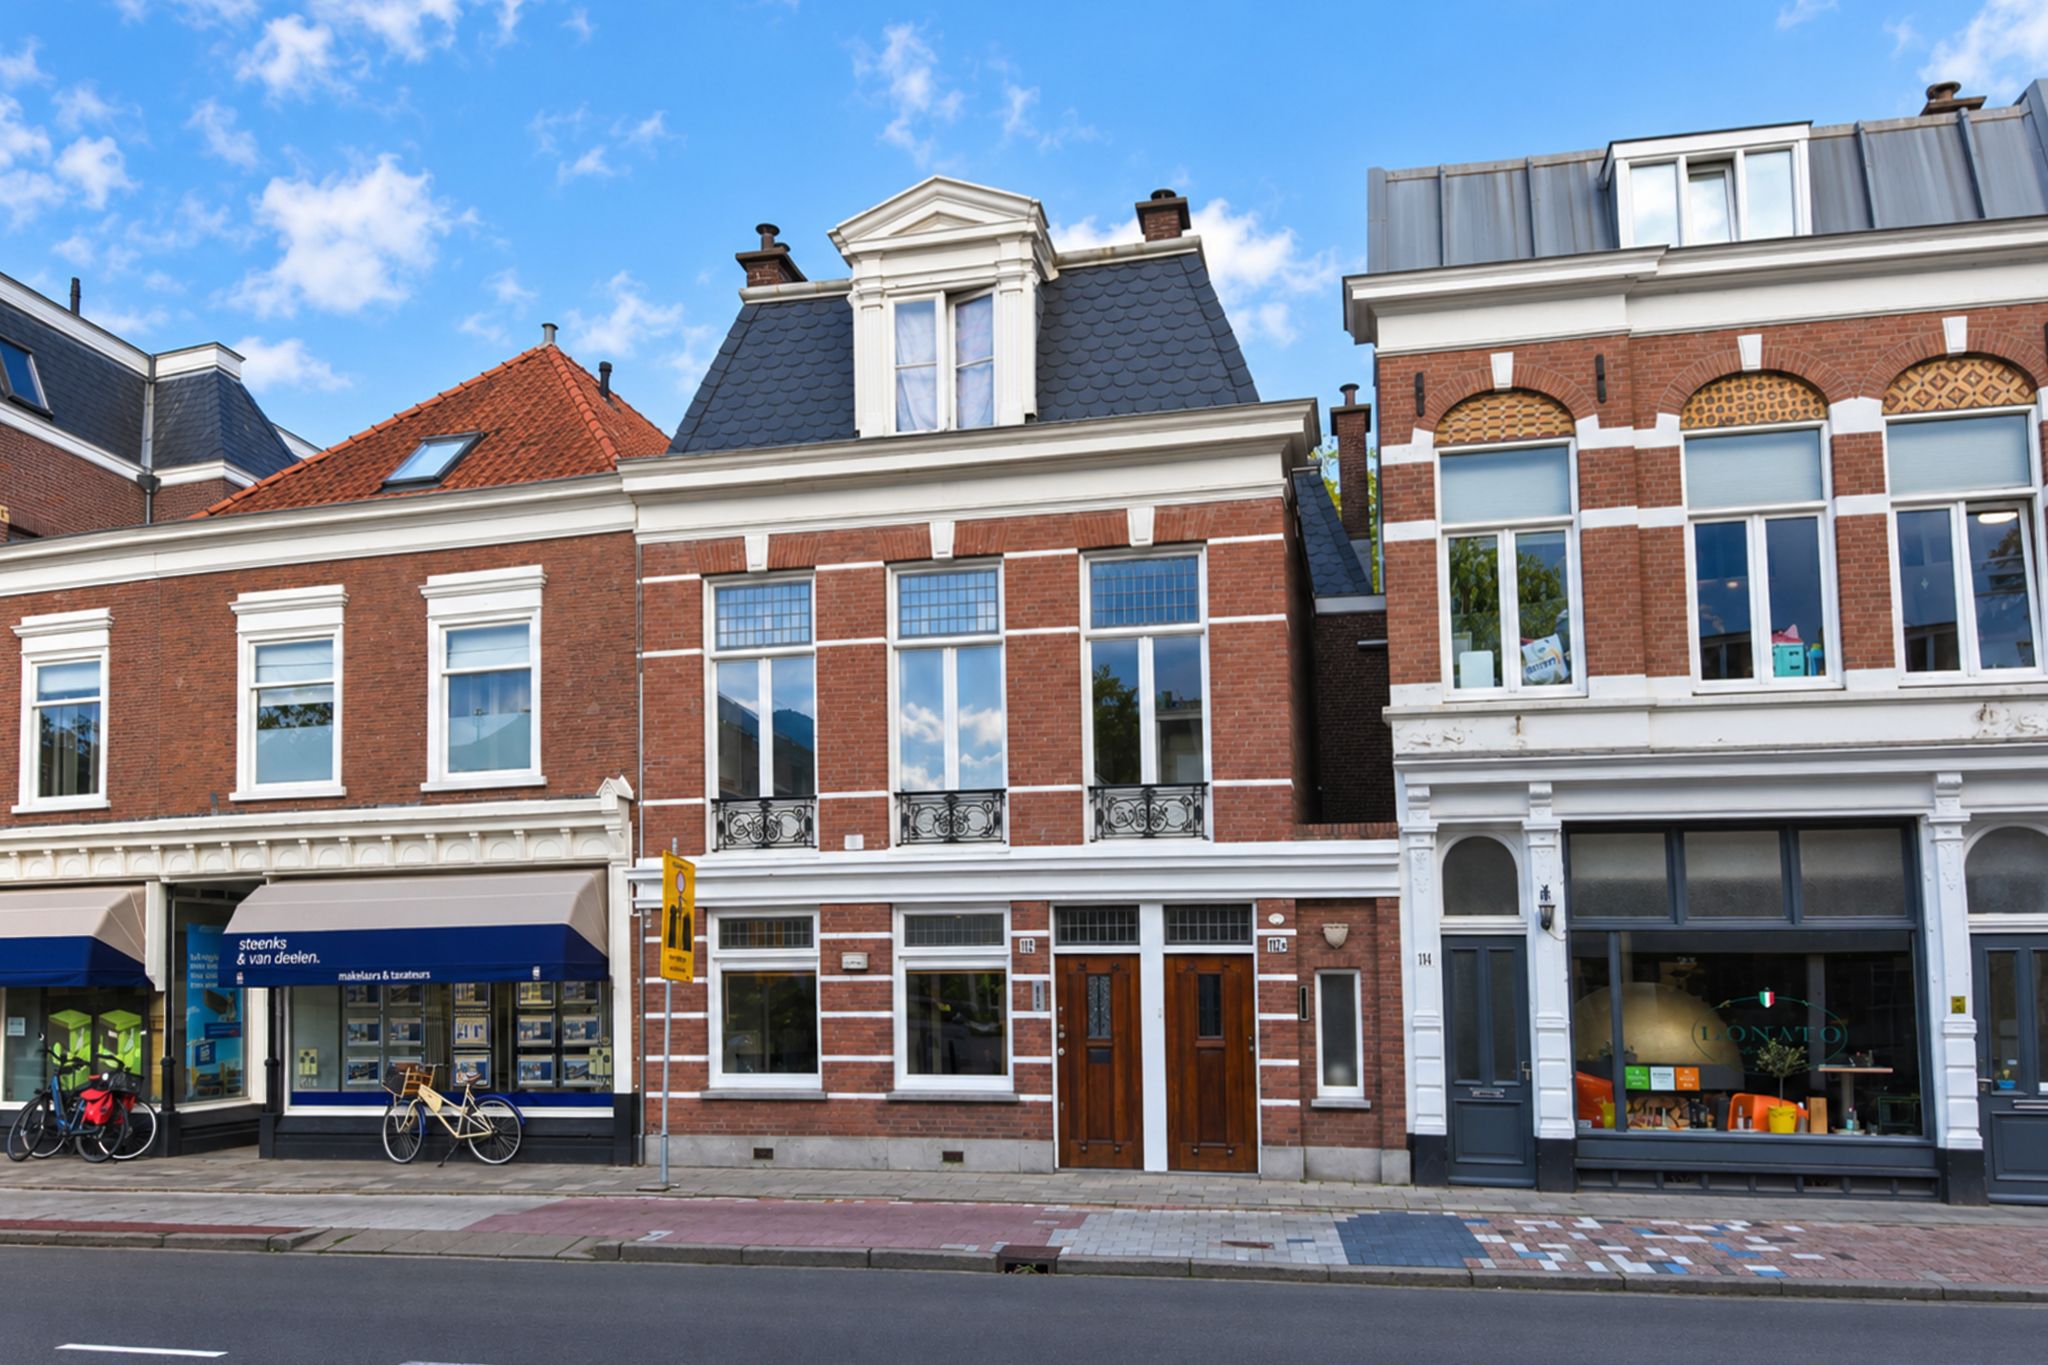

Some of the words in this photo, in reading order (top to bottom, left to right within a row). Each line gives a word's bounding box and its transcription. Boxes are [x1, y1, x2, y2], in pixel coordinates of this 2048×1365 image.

[239, 936, 287, 950] steenks
[236, 953, 246, 965] &
[249, 955, 272, 964] van
[274, 950, 321, 964] deelen.
[1418, 953, 1431, 965] 114
[382, 971, 389, 980] &
[1701, 1025, 1841, 1043] LONATO
